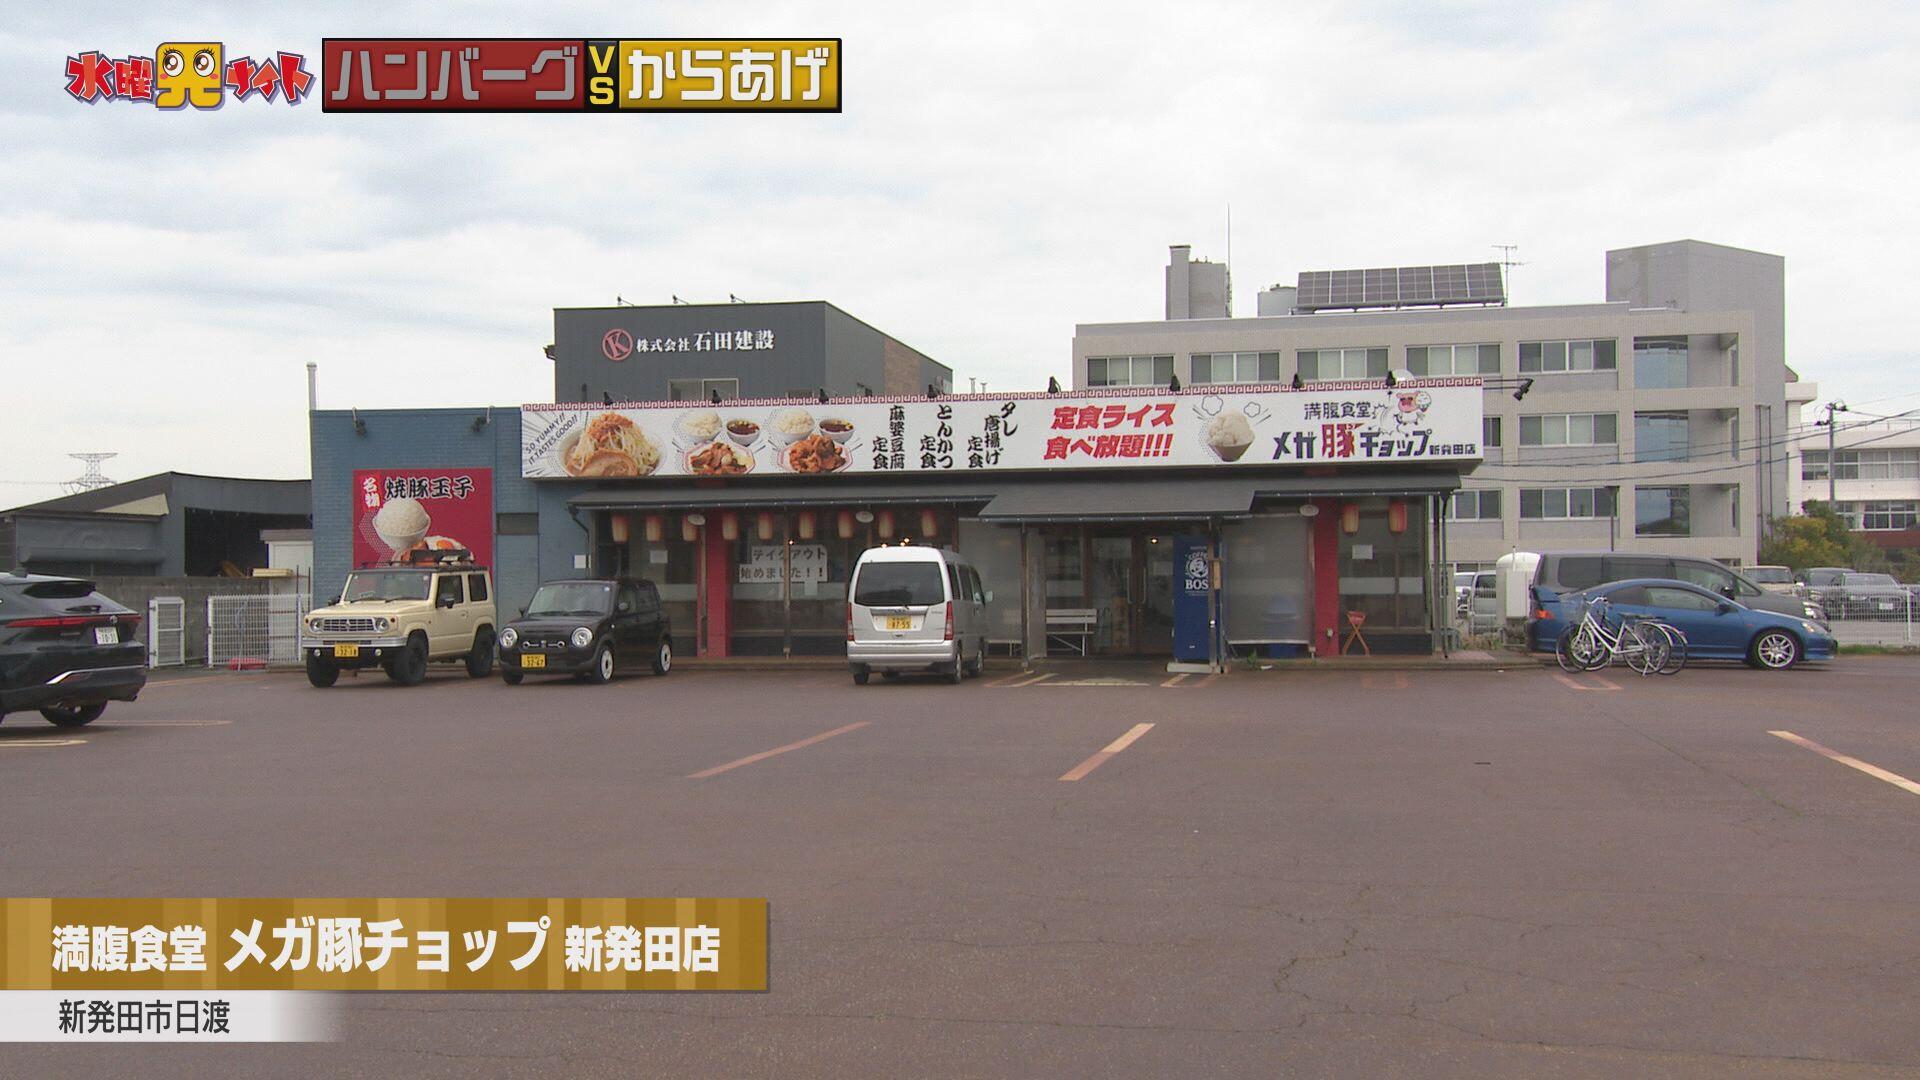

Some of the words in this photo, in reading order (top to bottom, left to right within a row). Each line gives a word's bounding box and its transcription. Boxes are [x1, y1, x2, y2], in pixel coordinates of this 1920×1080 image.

[636, 337, 691, 354] 株式会社
[693, 330, 775, 352] 石田建設
[1051, 403, 1176, 430] 定食ライス
[1303, 401, 1372, 421] 満腹食堂
[525, 442, 536, 454] SO
[536, 412, 566, 444] YUMMY!!
[534, 437, 557, 459] TASTES
[555, 414, 578, 439] GOOD!!
[889, 404, 906, 470] 麻婆豆腐
[937, 404, 954, 469] とんかつ
[984, 414, 1004, 466] 唐揚げ
[1043, 433, 1174, 461] 食べ放題!!!
[1272, 422, 1433, 460] メガ豚チョップ
[1429, 443, 1476, 456] 新発田店
[872, 435, 889, 470] 定食
[920, 434, 937, 469] 定食
[967, 435, 984, 469] 定食
[362, 477, 381, 508] 名物
[384, 475, 475, 500] 焼豚玉子
[1185, 579, 1209, 590] BOS
